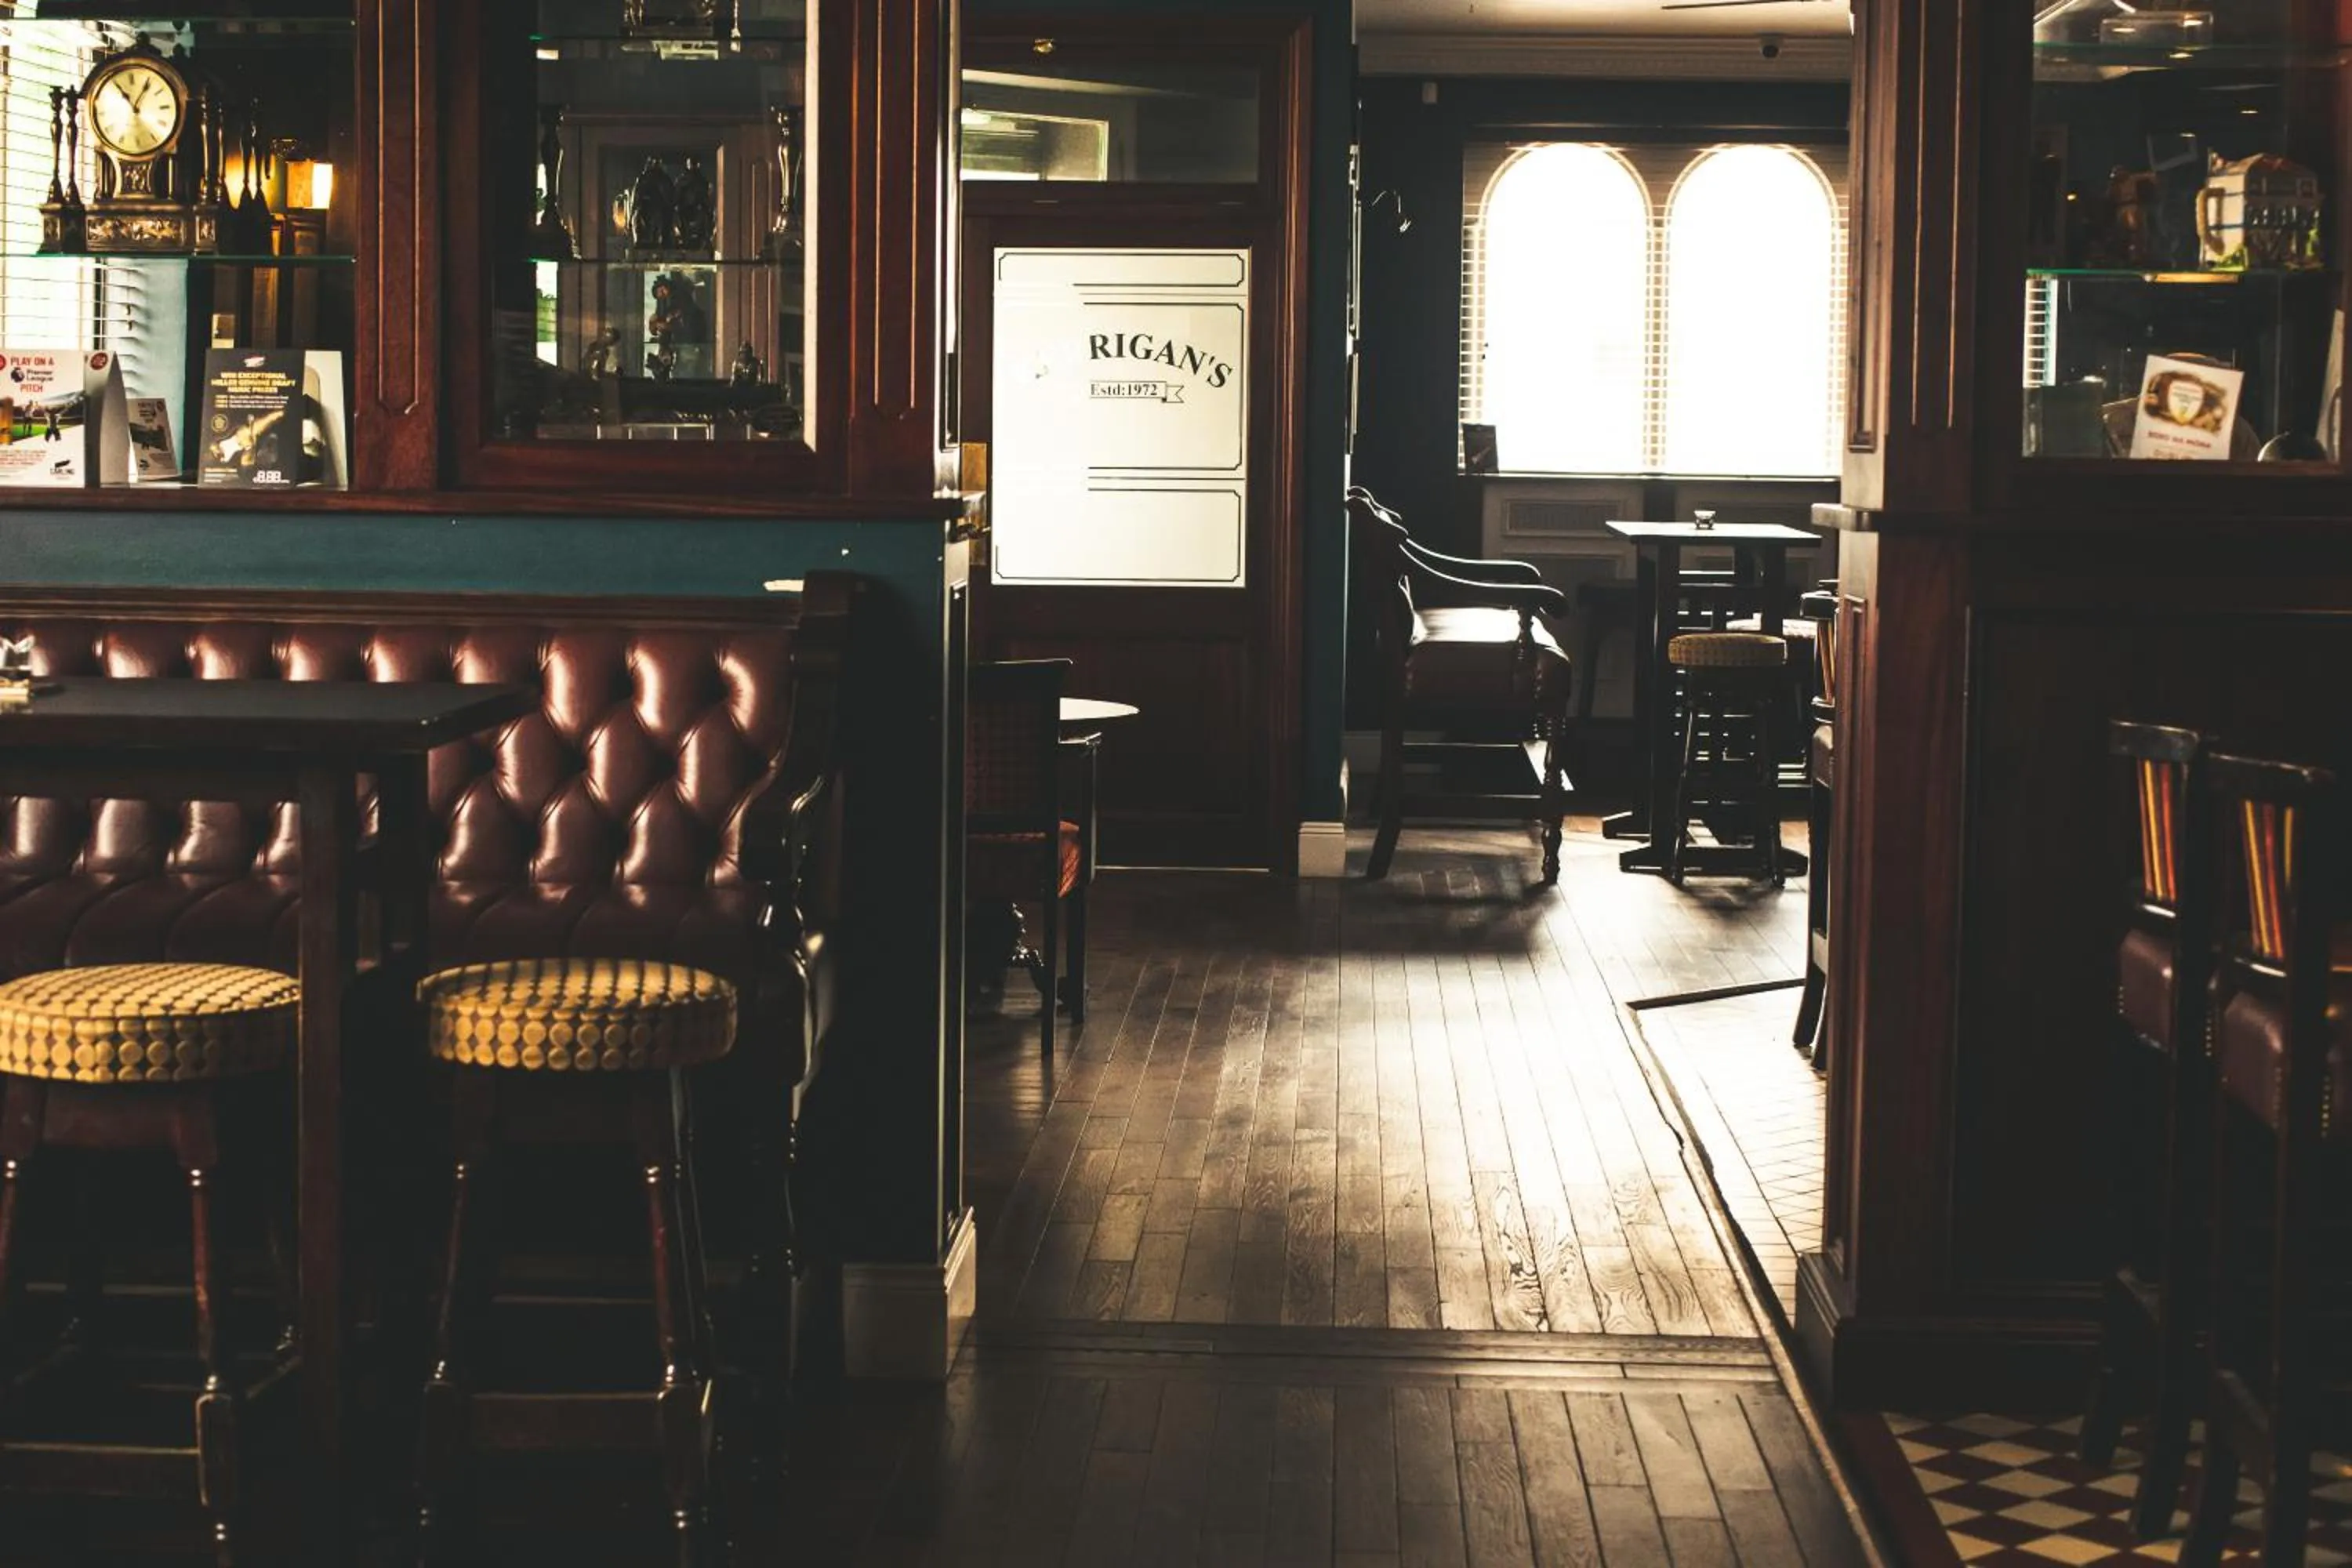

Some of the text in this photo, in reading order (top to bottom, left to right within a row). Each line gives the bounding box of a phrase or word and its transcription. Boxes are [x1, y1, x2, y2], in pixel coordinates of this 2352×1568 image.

[10, 357, 31, 366] PLAY
[34, 357, 46, 366] ON
[48, 357, 55, 366] A
[1090, 333, 1232, 388] RIGAN'S
[20, 384, 43, 393] PITCH
[1091, 383, 1158, 396] Estd:1972
